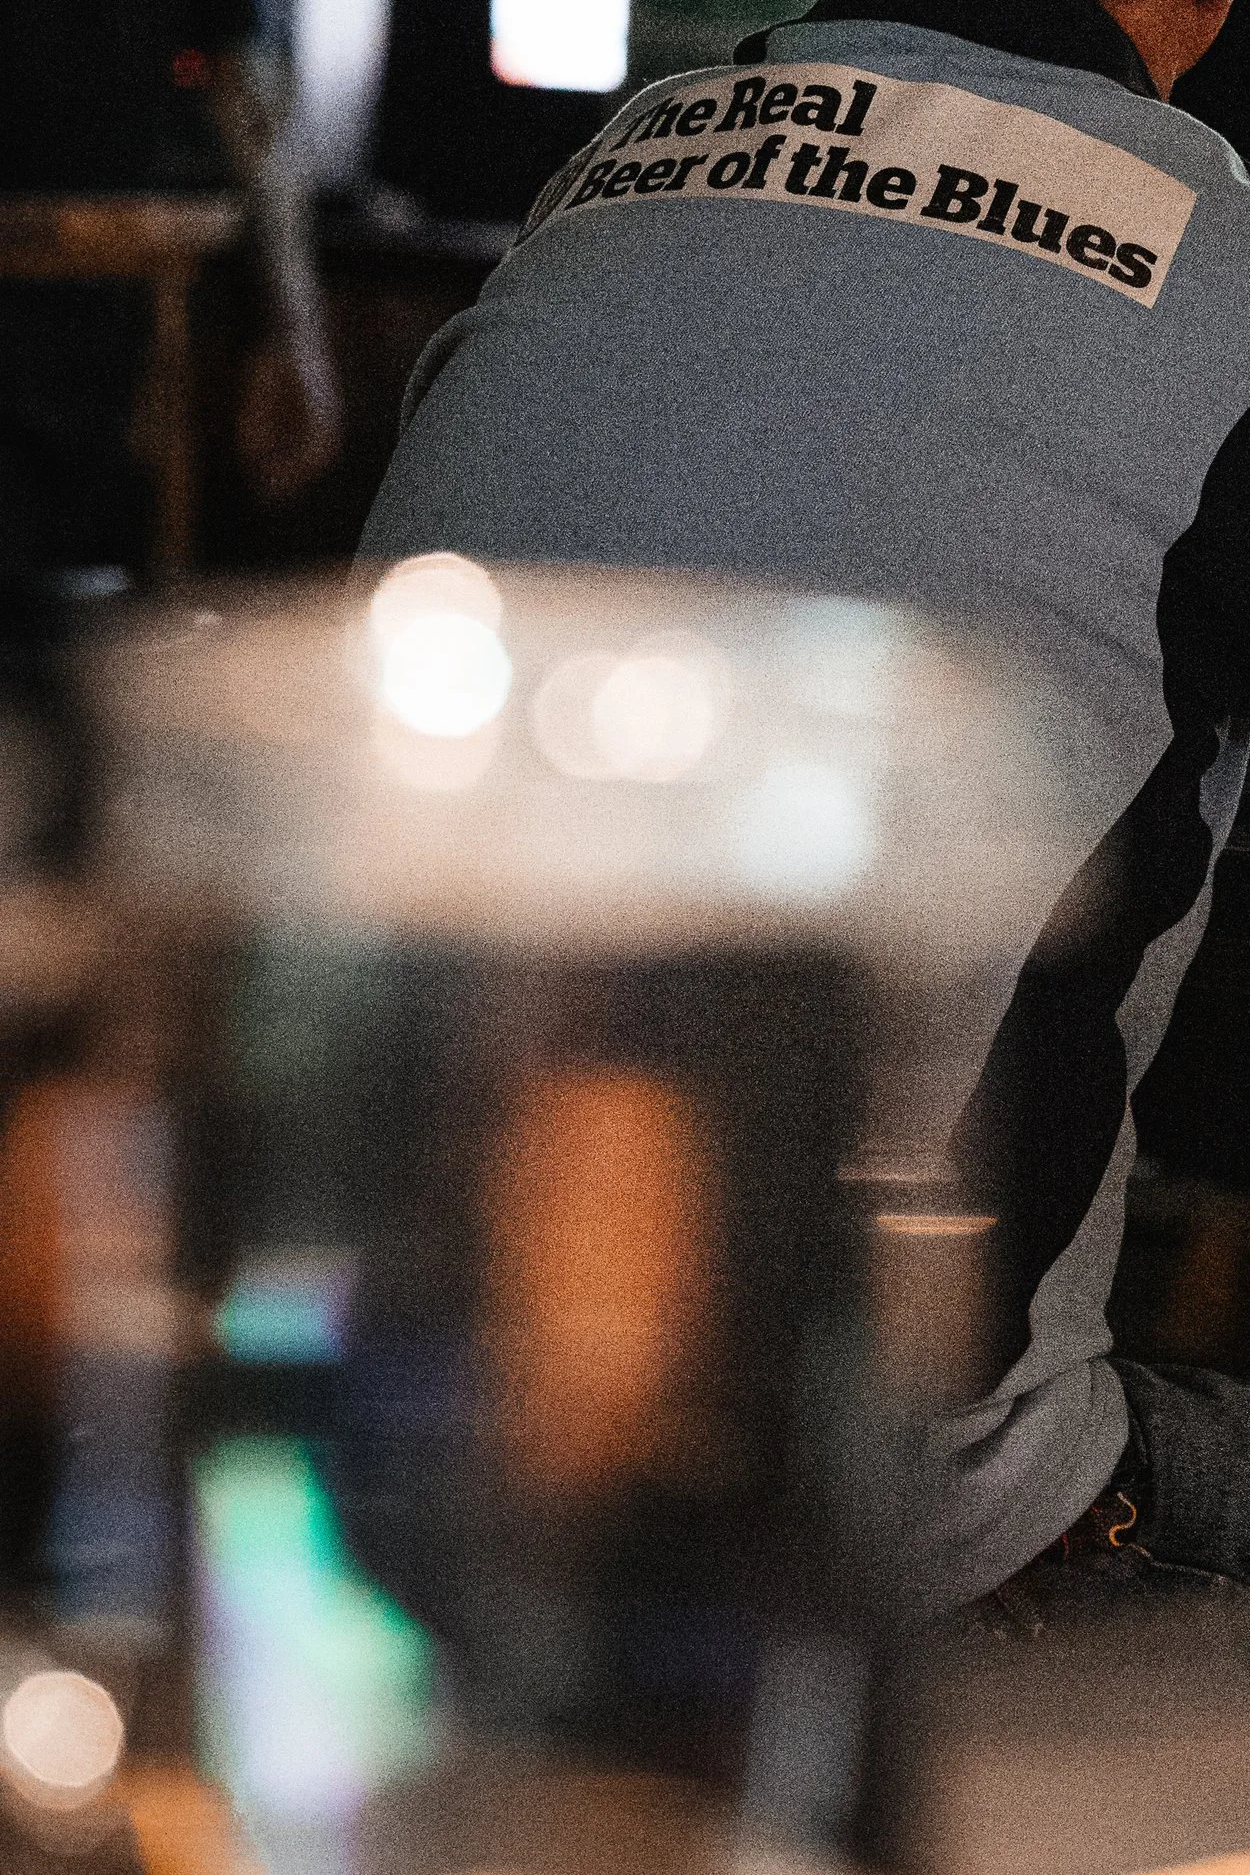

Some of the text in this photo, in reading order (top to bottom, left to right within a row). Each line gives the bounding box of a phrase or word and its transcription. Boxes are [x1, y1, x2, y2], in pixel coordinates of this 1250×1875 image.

[608, 75, 878, 153] The Real
[564, 135, 1158, 289] Beer of the Blues
